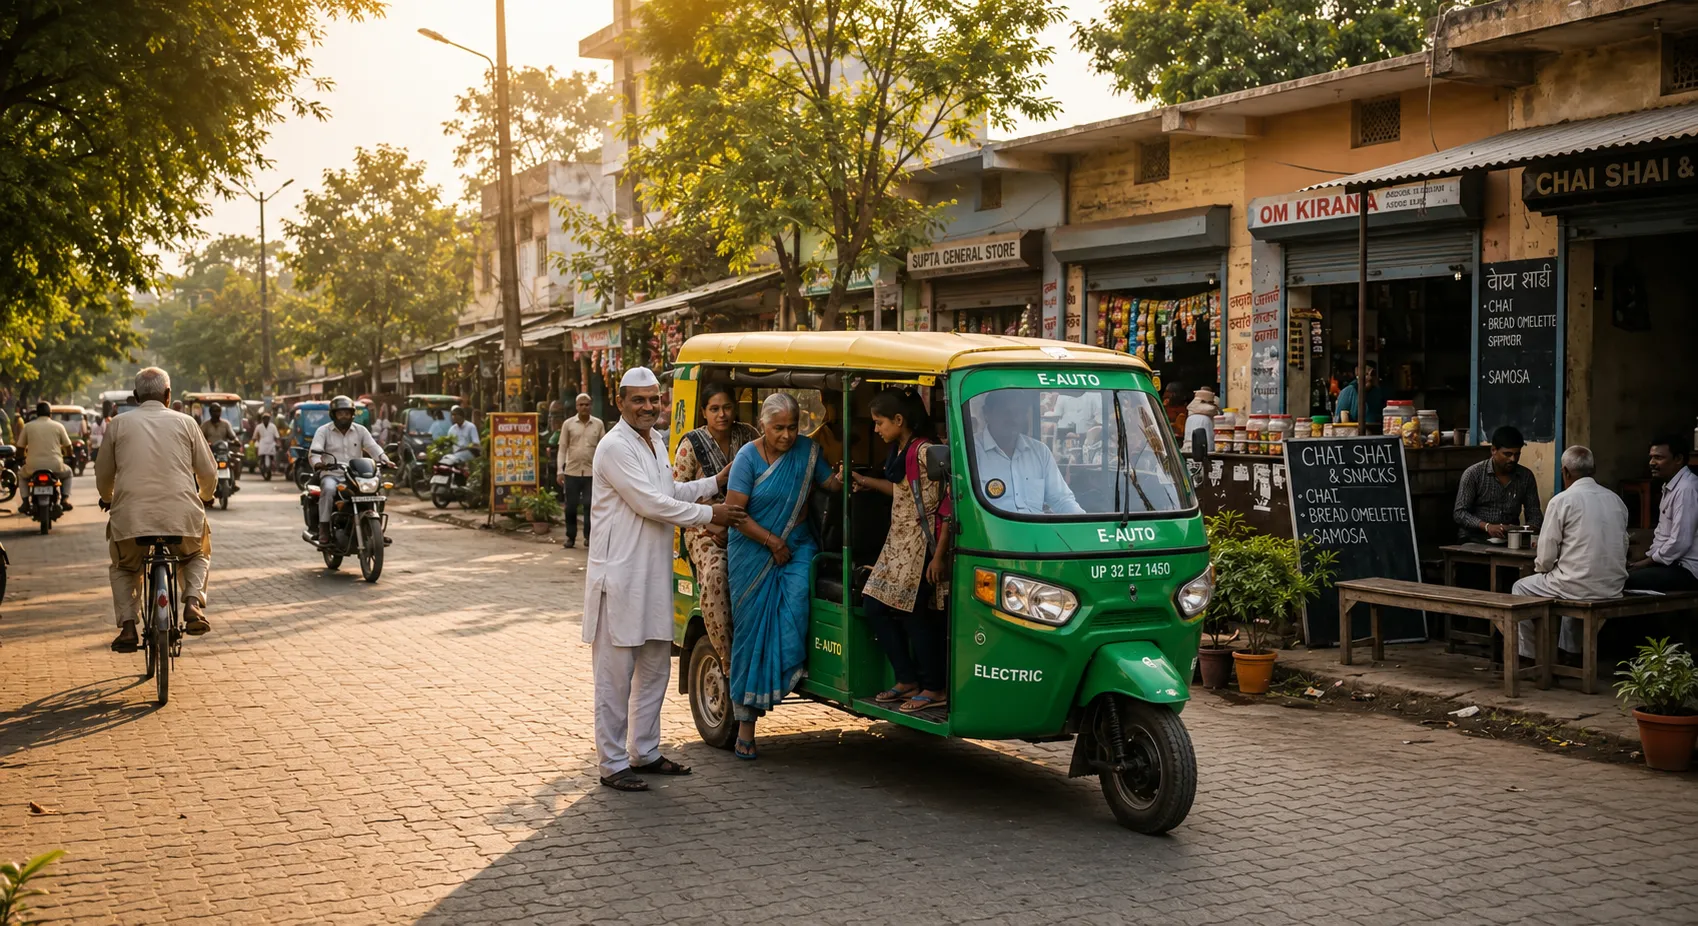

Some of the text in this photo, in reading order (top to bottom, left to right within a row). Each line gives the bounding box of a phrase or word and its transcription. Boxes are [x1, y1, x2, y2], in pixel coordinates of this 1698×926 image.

[1536, 155, 1695, 196] CHAI SHAI &
[1260, 204, 1288, 224] OM
[1296, 192, 1379, 220] KIRANA
[912, 241, 1016, 269] SUPTA GENERAL STORE
[1488, 298, 1514, 313] CHAI
[1488, 314, 1557, 330] BREAD OMELETTE
[1037, 373, 1101, 387] E-AUTO
[1488, 368, 1531, 385] SAMOSA
[1301, 443, 1396, 467] CHAI SHAI
[1329, 466, 1397, 484] & SNACKS
[1305, 487, 1341, 504] CHAI
[1308, 506, 1408, 524] BREAD OMELETTE
[1097, 526, 1156, 543] E-AUTO
[1312, 527, 1369, 545] SAMOSA
[1091, 561, 1171, 578] UP 32 EZ 1450
[814, 636, 842, 656] E-AUTO
[974, 663, 1044, 683] ELECTRIC
